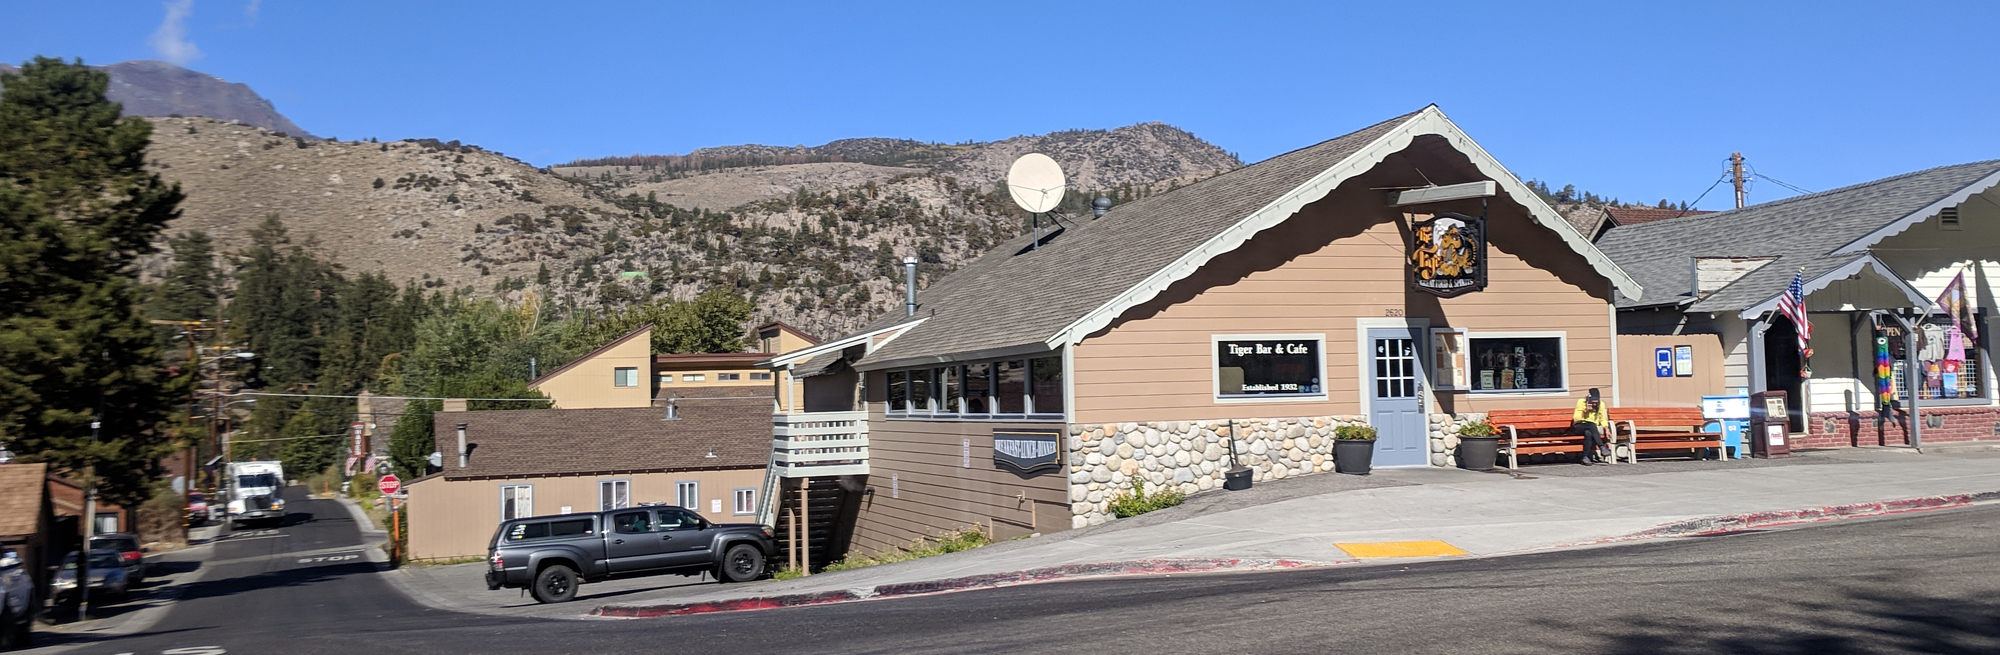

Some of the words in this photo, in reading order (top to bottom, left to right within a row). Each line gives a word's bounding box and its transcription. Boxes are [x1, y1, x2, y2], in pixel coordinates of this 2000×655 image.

[1385, 309, 1403, 317] 2620
[1228, 343, 1253, 356] Tiger
[1255, 343, 1272, 354] Bar
[1274, 343, 1284, 354] &
[1286, 343, 1308, 354] Cafe
[1242, 383, 1278, 391] Established
[1280, 383, 1298, 391] 1932
[380, 480, 400, 489] STOP
[297, 554, 359, 564] STOP
